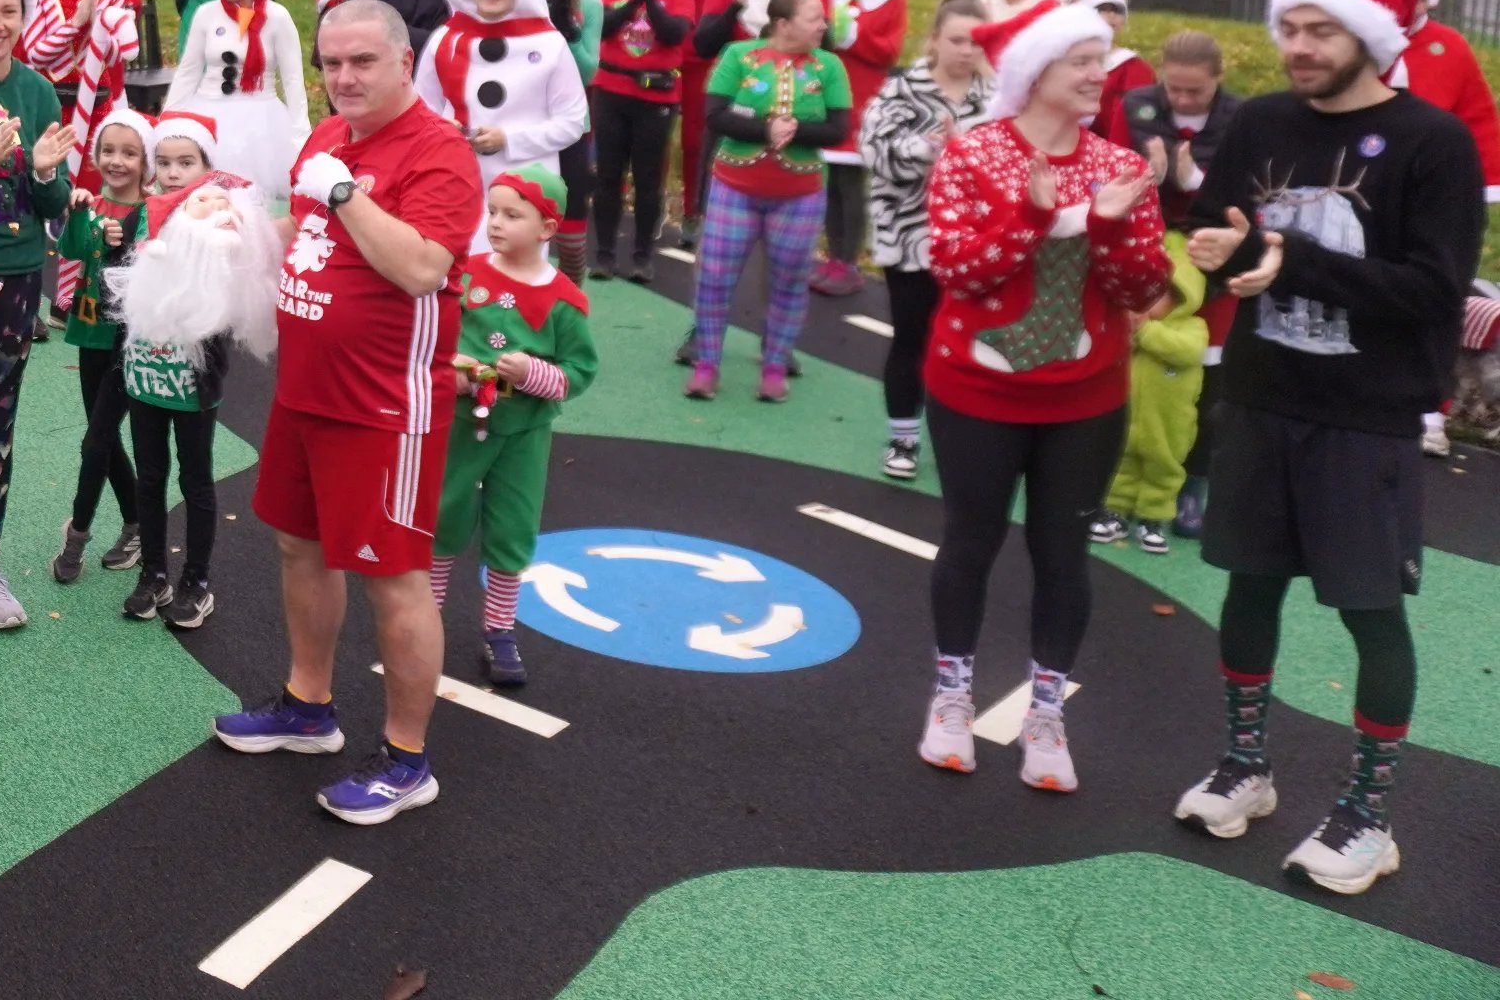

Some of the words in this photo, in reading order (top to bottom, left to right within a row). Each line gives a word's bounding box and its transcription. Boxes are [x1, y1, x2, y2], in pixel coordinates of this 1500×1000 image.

[279, 267, 309, 300] EAR
[307, 290, 333, 305] THE
[277, 290, 324, 321] EARD
